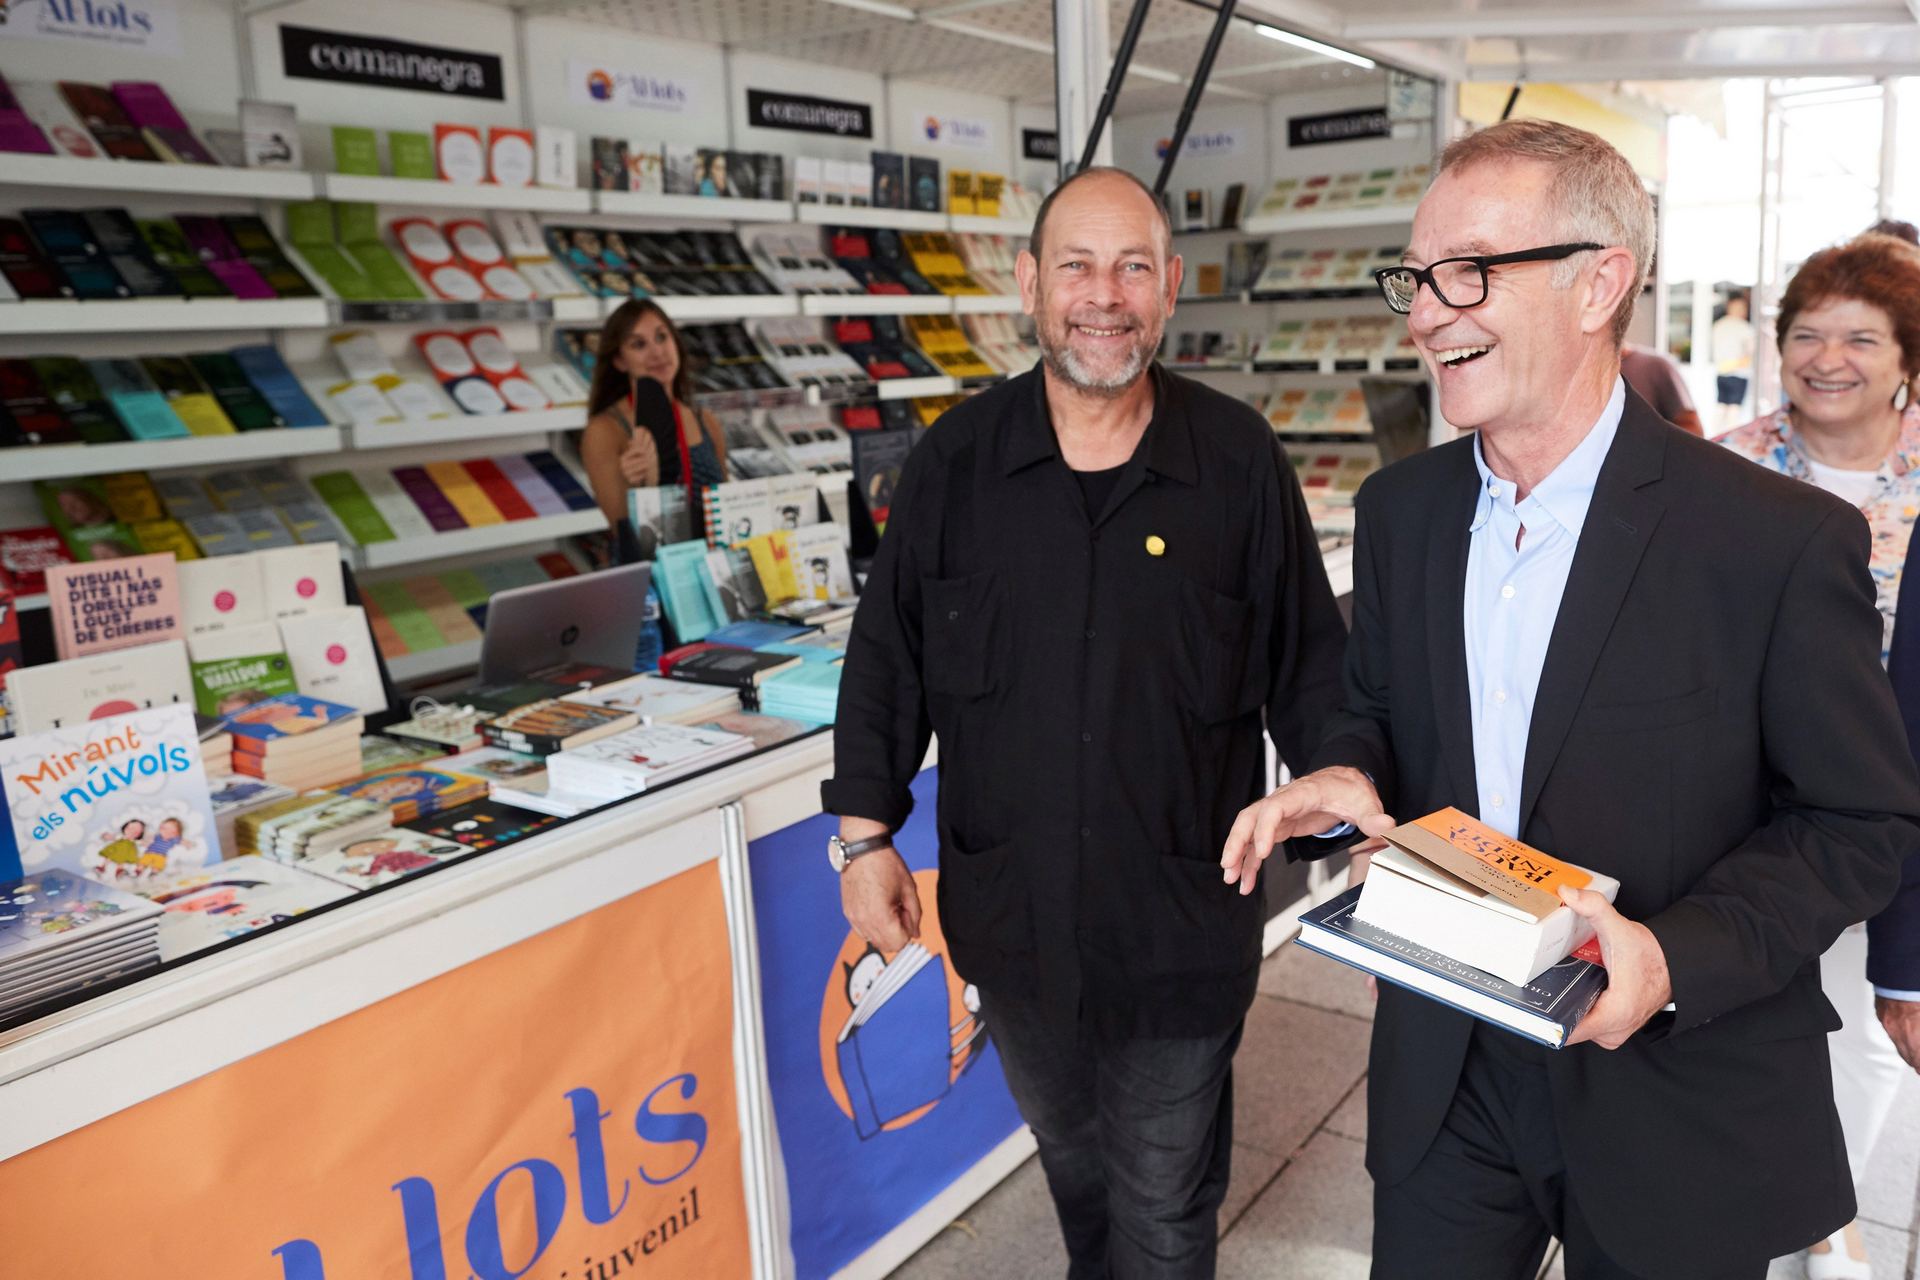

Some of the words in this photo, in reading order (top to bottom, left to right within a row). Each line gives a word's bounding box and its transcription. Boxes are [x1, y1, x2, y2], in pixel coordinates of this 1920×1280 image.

[309, 43, 486, 92] comanegra
[66, 569, 132, 588] VISUAL
[138, 567, 143, 579] I
[69, 585, 111, 602] DITS
[117, 584, 122, 596] I
[128, 578, 162, 593] NAS
[71, 604, 77, 616] I
[83, 592, 157, 615] ORELLES
[73, 618, 79, 631] I
[85, 610, 132, 628] GUST
[76, 630, 98, 645] DE
[104, 615, 175, 640] CIRERES
[16, 725, 141, 795] Mirant
[32, 812, 65, 841] els
[60, 742, 191, 813] núvols
[1372, 935, 1430, 961] LLIBRE
[1434, 960, 1480, 981] GRAN
[1483, 977, 1504, 991] EL
